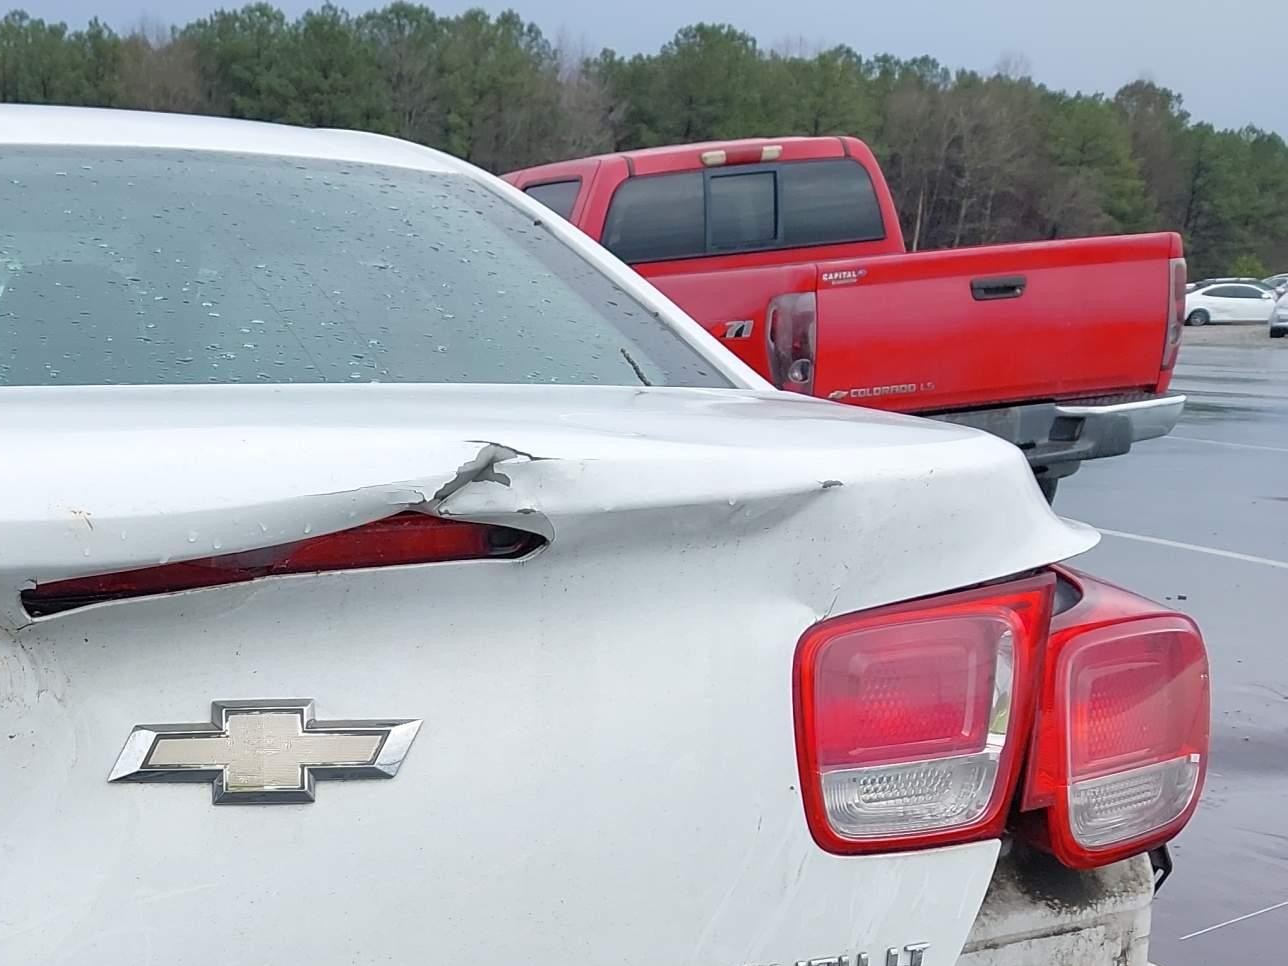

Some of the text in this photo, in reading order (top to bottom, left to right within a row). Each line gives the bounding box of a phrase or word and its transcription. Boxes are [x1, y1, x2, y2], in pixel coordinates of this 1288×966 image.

[822, 270, 858, 281] CAPITAL
[850, 382, 935, 398] COLORADO LS
